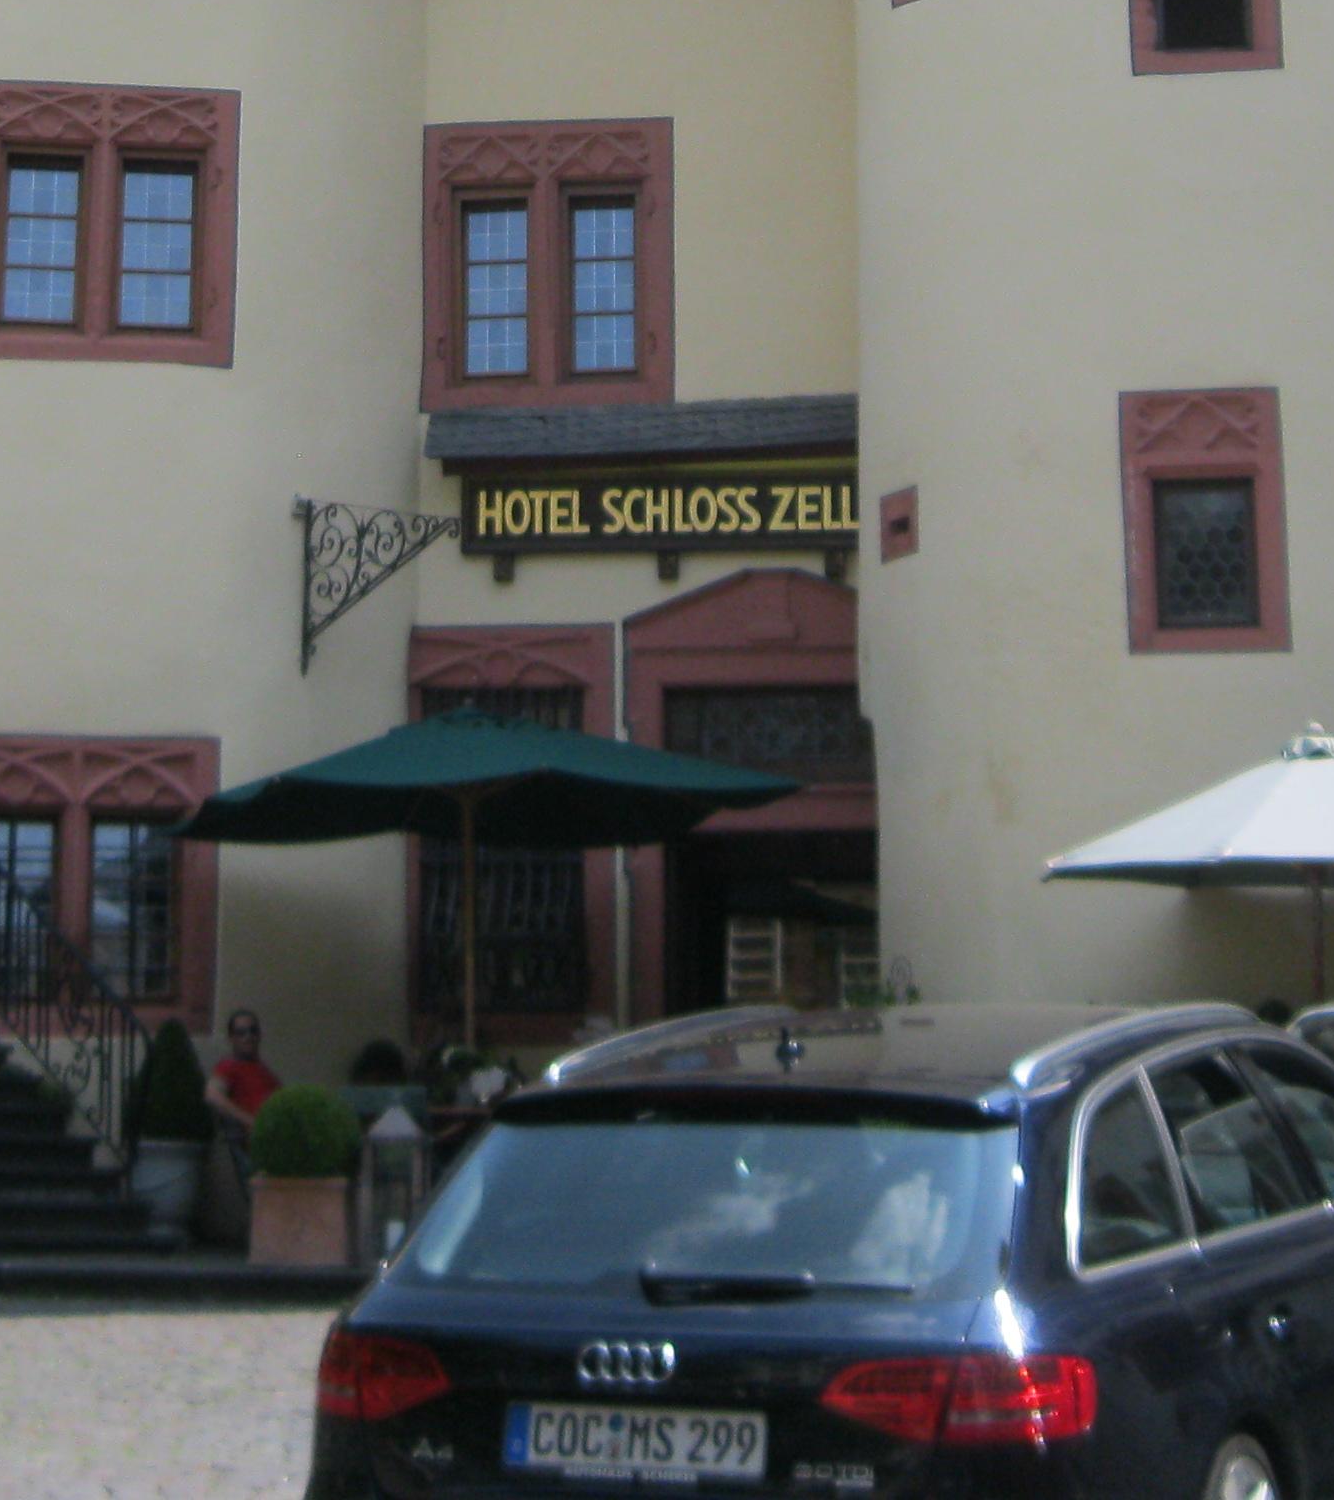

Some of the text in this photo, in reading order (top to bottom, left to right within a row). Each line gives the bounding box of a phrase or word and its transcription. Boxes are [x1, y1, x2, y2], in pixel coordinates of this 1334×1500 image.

[479, 485, 859, 534] HOTEL SCHLOSS ZELL
[533, 1411, 757, 1466] COC MS 299
